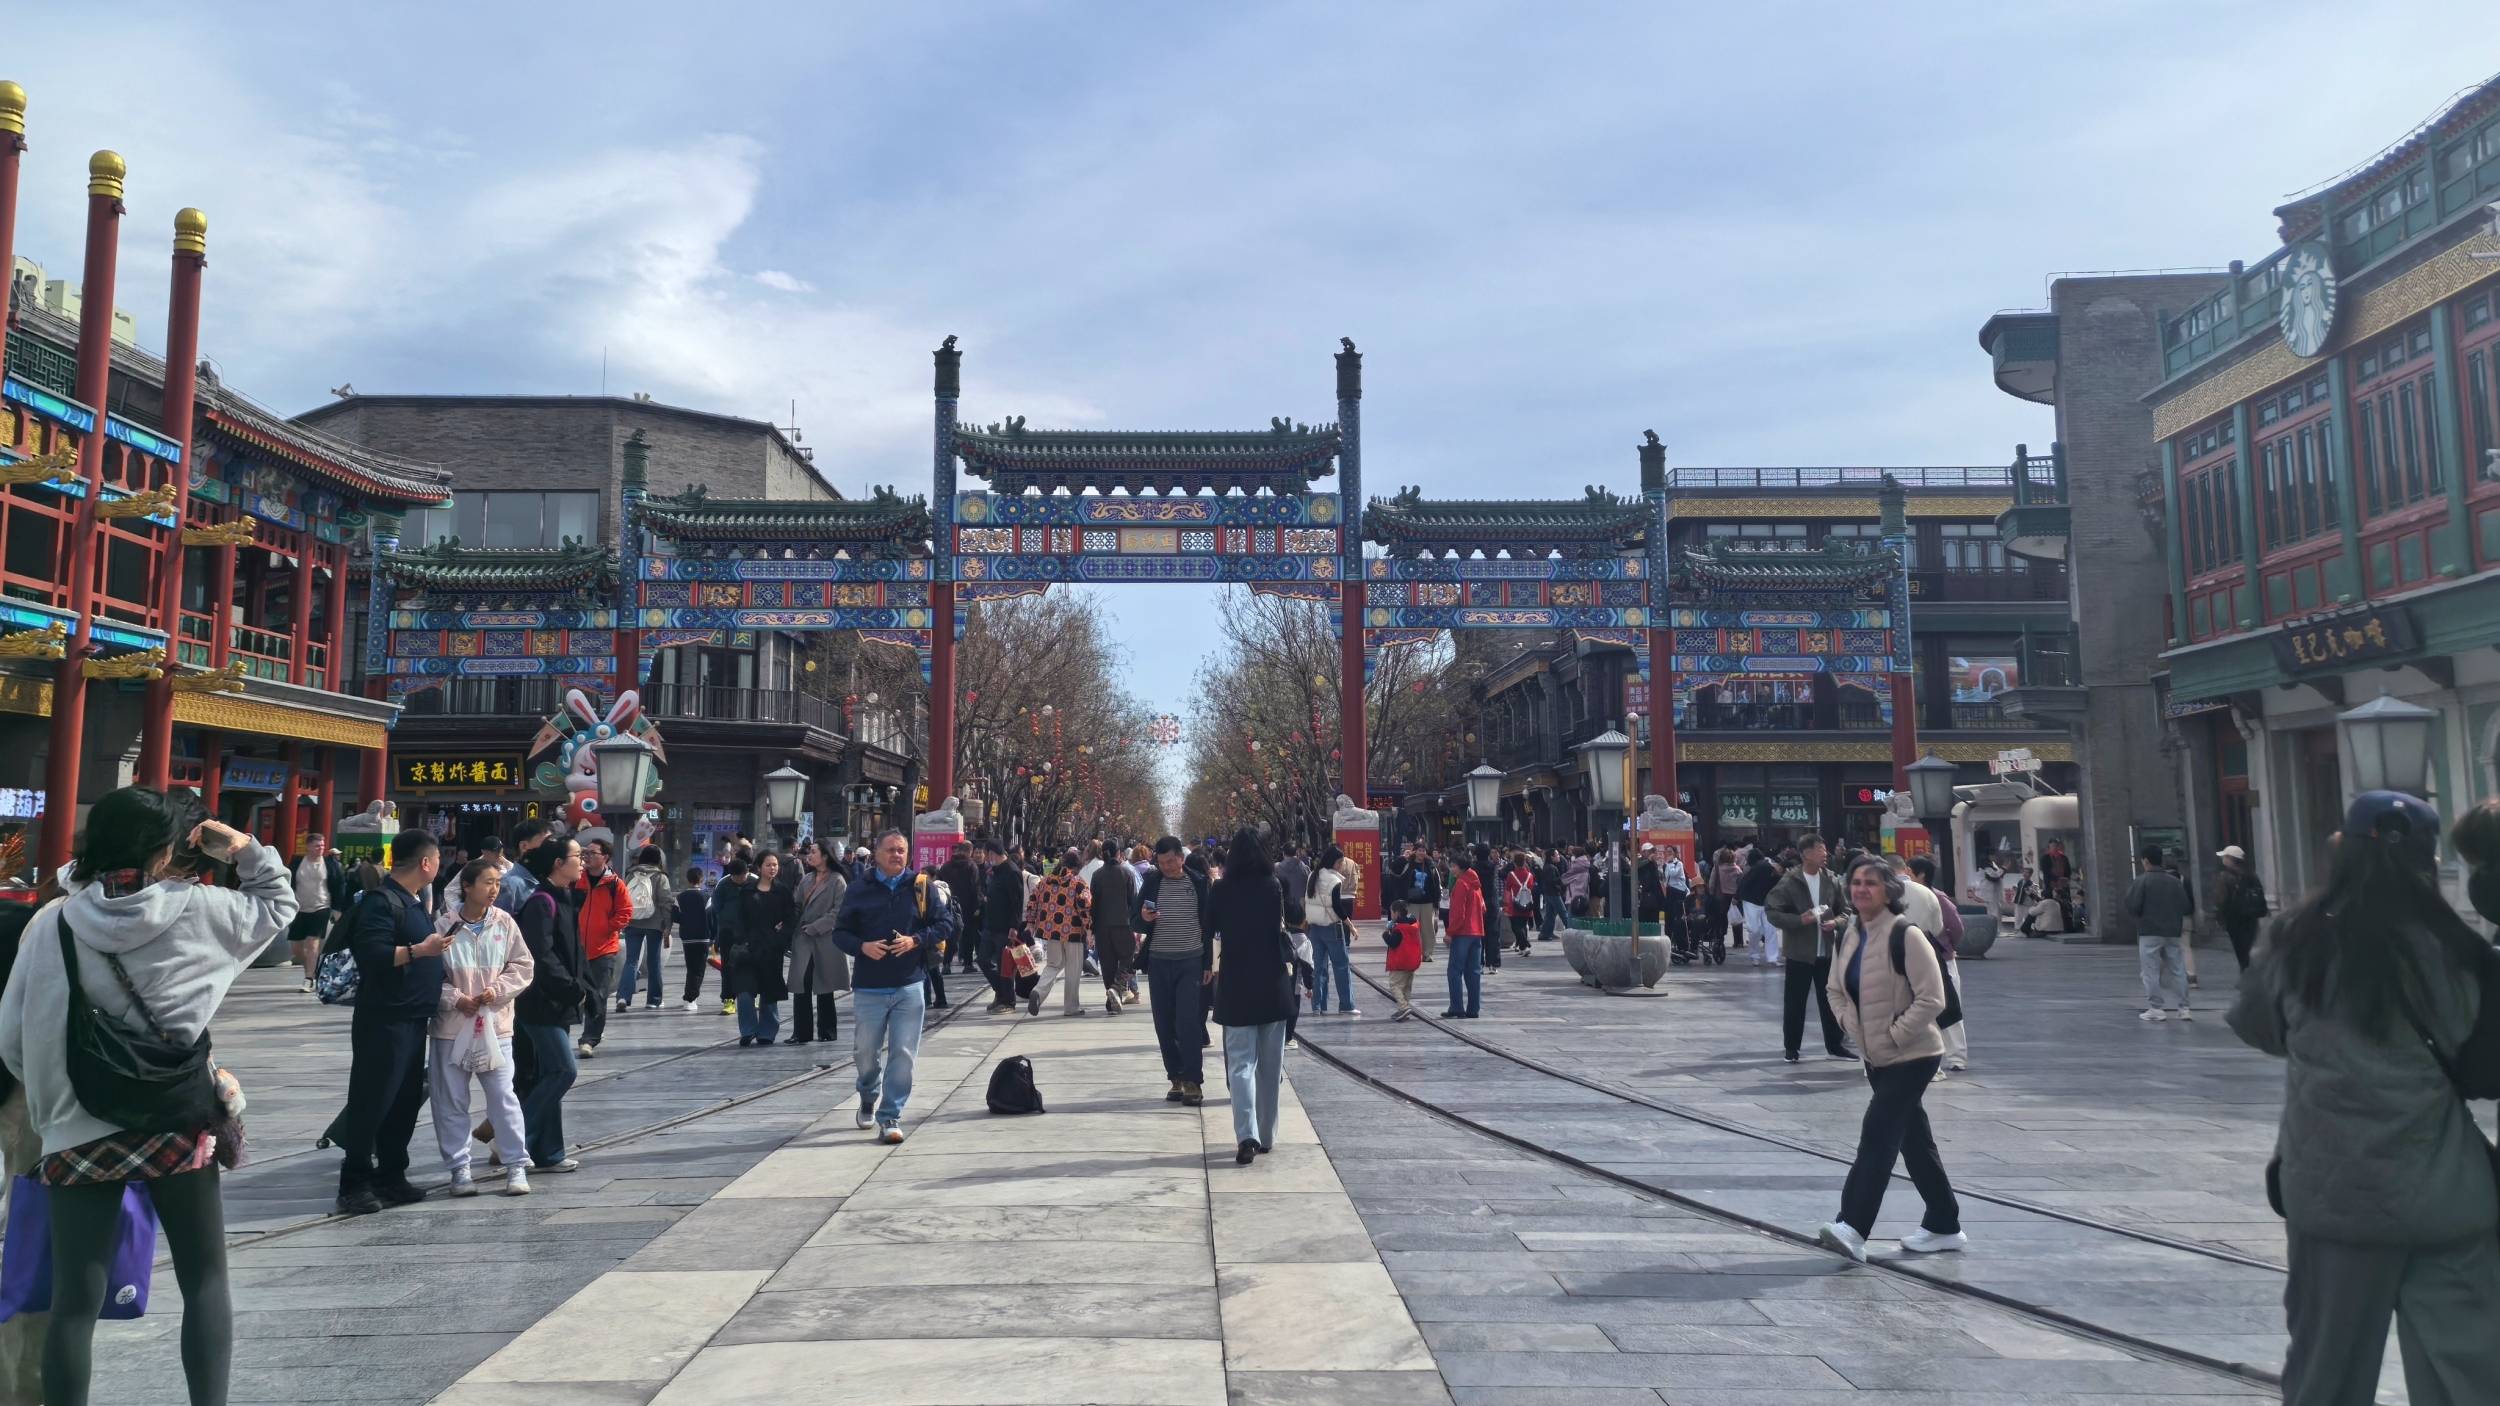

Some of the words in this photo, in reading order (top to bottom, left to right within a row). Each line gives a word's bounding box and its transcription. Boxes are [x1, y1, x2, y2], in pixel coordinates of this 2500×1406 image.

[2292, 617, 2388, 665] 星巴克咖啡
